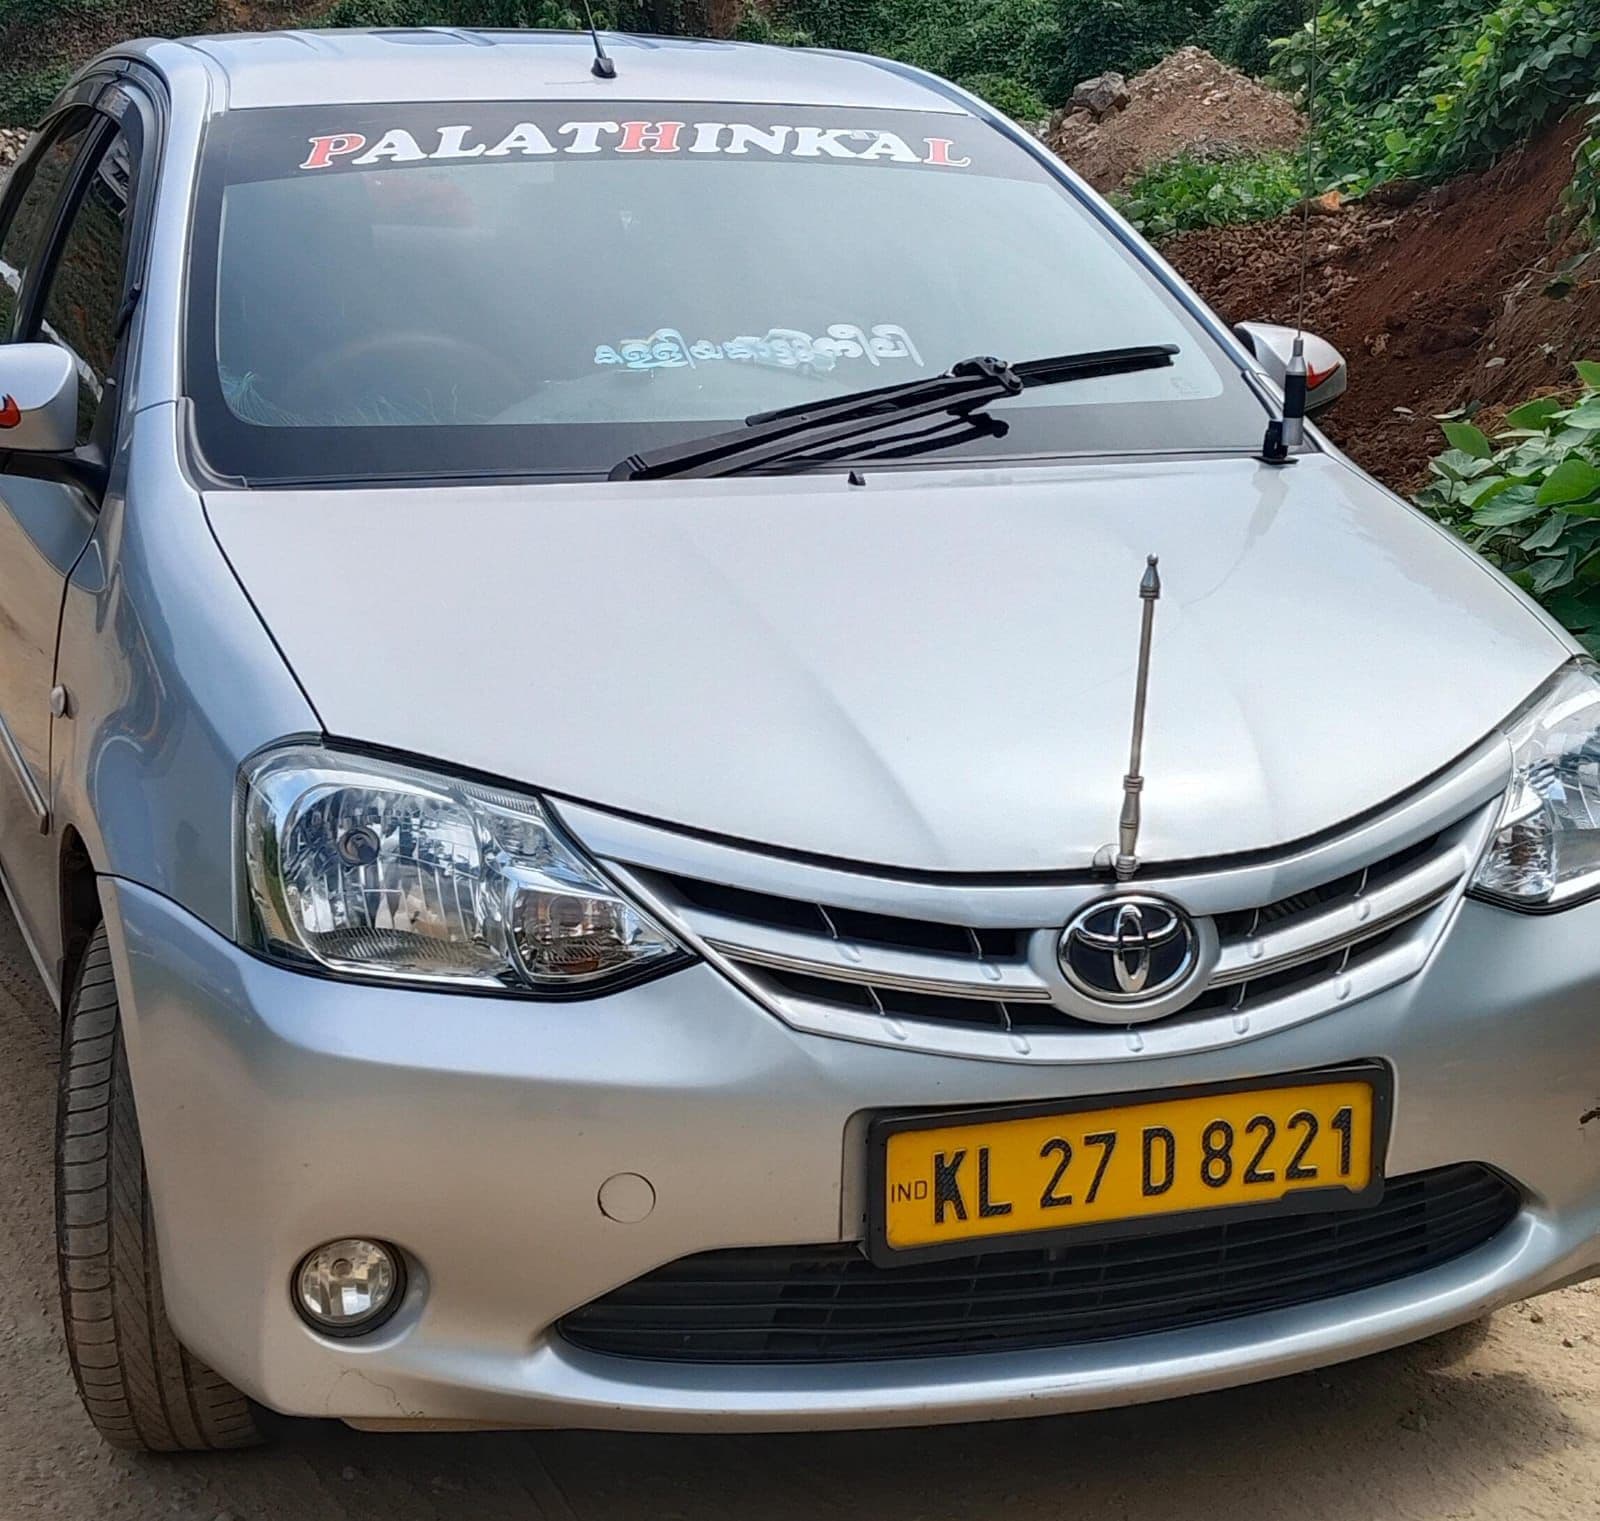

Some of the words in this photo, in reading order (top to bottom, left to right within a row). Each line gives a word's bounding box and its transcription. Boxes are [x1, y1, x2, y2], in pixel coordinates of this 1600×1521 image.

[300, 121, 971, 169] PALATHINKAL
[933, 1147, 1012, 1224] KL
[1039, 1131, 1117, 1209] 27
[1141, 1126, 1176, 1197] D
[1200, 1106, 1354, 1188] 8221
[891, 1180, 928, 1203] IND
